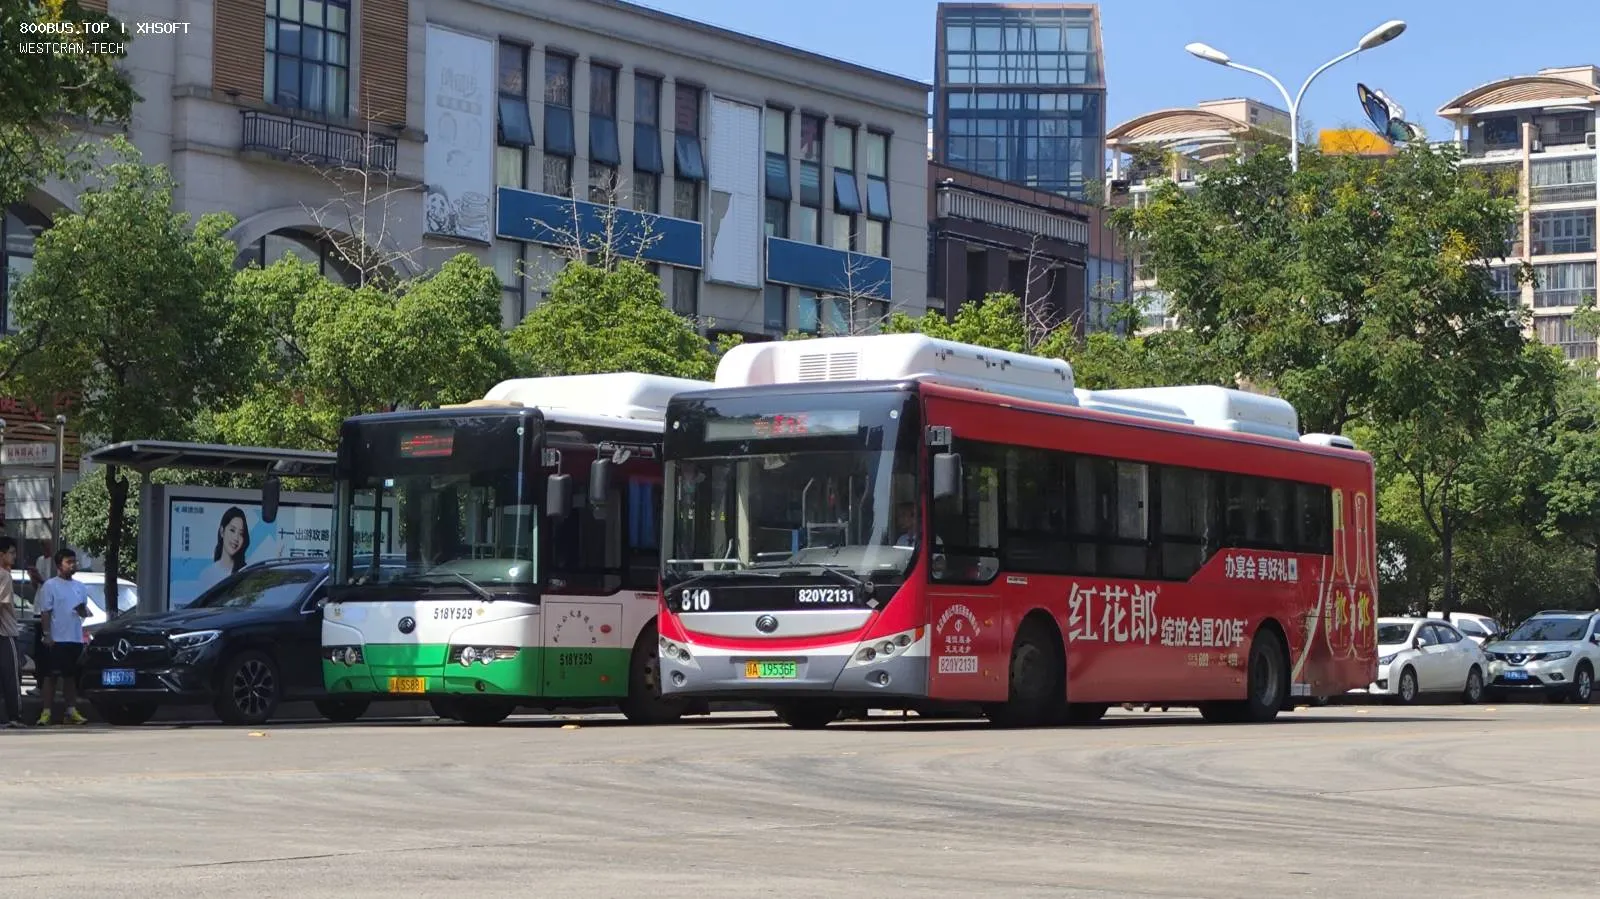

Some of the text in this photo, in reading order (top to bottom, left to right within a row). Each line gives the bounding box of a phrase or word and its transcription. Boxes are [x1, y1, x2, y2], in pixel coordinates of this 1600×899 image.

[1225, 554, 1288, 581] 办宴会 享好礼
[681, 589, 711, 611] 810
[798, 588, 855, 603] 820Y2131
[433, 607, 473, 620] 518Y529
[1068, 582, 1159, 645] 红花郎
[559, 652, 593, 667] 518Y529
[940, 657, 977, 672] 820Y2131
